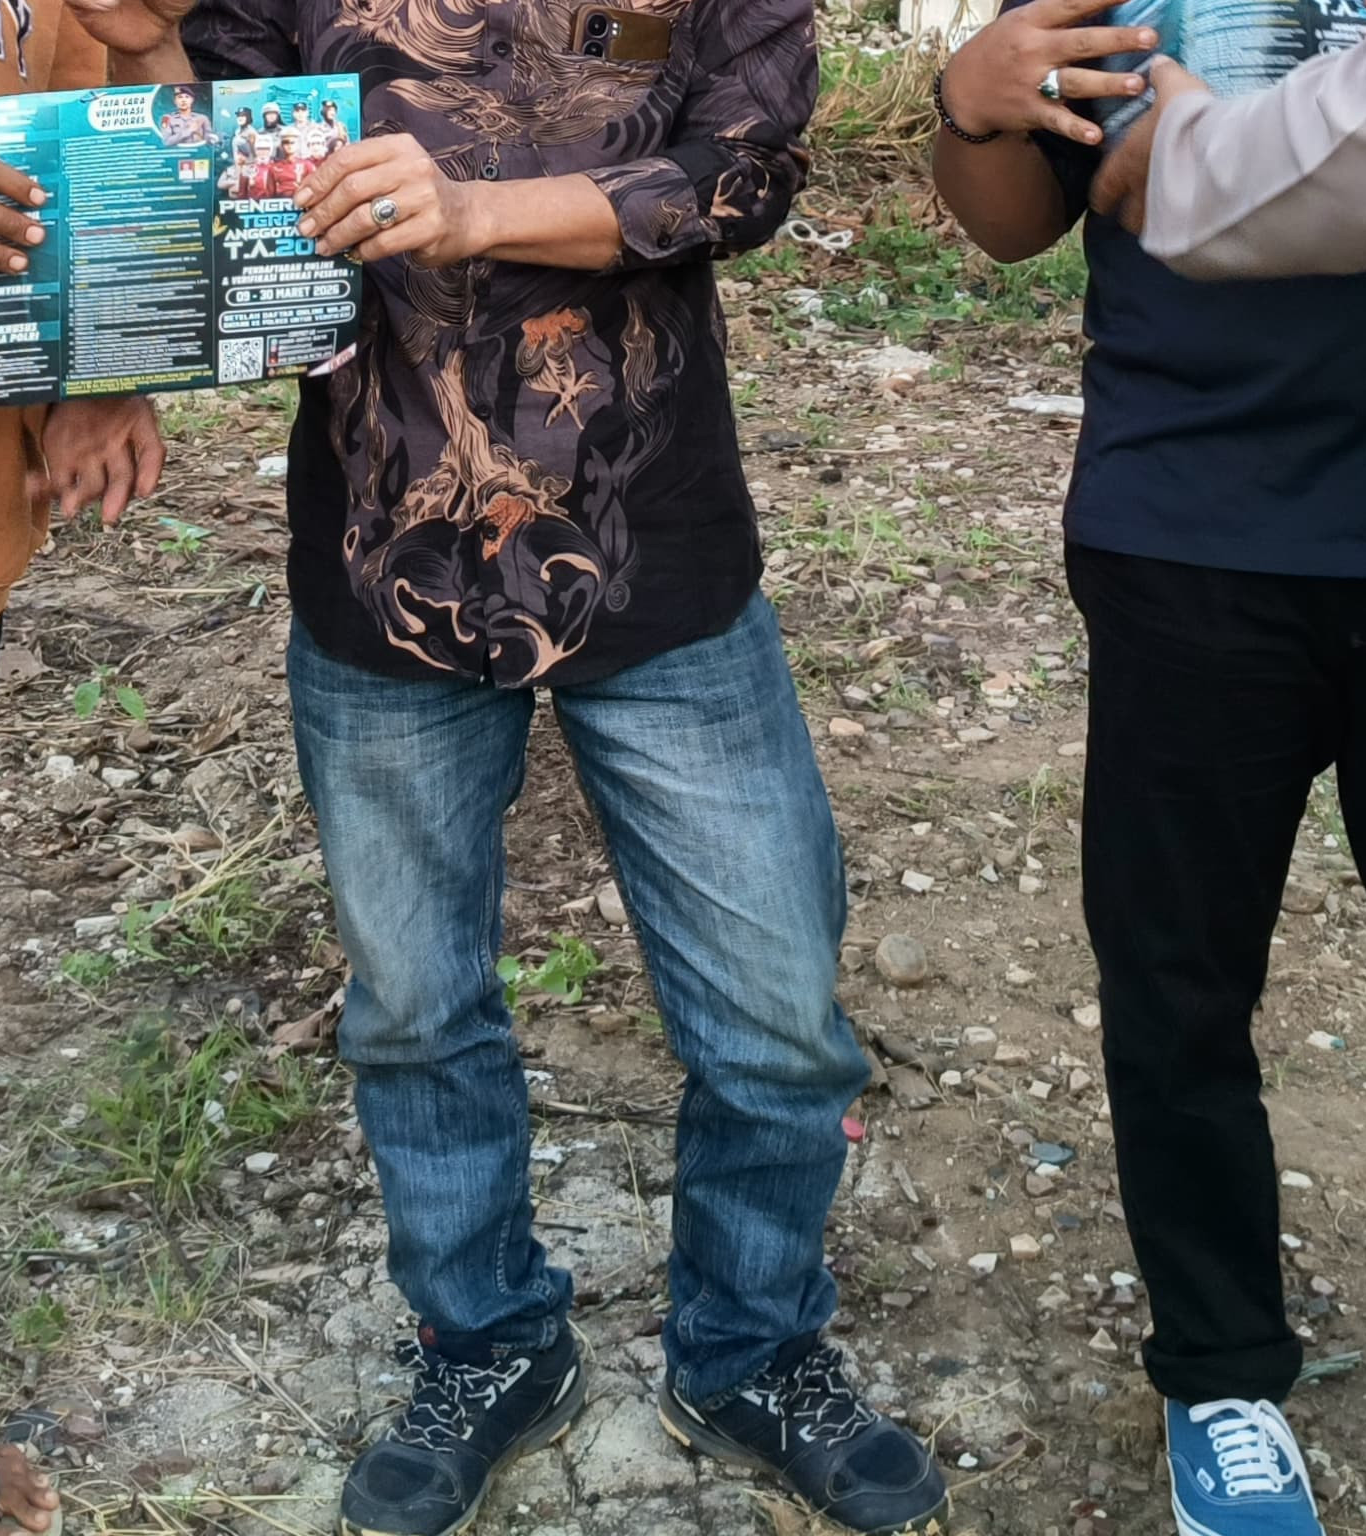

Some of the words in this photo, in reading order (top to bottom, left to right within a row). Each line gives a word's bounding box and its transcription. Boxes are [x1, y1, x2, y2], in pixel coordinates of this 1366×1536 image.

[98, 98, 120, 107] TATA
[122, 96, 146, 106] CARA
[95, 107, 144, 118] VERIFIKASI
[101, 119, 111, 128] DI
[113, 117, 146, 127] POLRES
[239, 213, 301, 228] TERP
[242, 263, 303, 275] PENDAFTARAN
[304, 261, 335, 270] ONLINE
[231, 273, 278, 285] VERIFIKASI
[236, 290, 251, 302] 09
[260, 288, 274, 300] 30
[276, 286, 311, 299] MARET
[313, 284, 340, 295] 2026
[10, 331, 40, 343] POLRI
